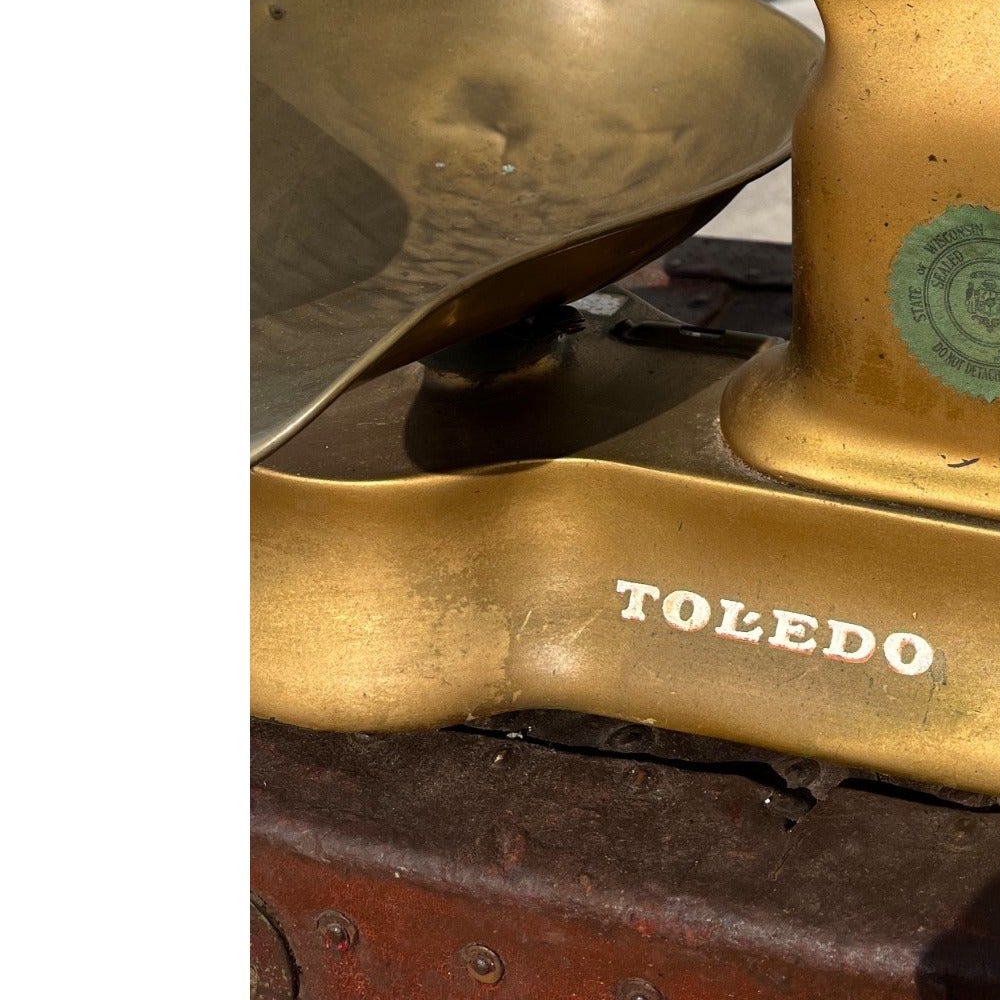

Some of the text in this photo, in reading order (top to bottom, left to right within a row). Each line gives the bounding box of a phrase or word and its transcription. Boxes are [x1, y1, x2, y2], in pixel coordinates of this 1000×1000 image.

[923, 223, 986, 255] WISCONSIN
[917, 263, 927, 276] OF
[931, 250, 965, 290] SEALED
[908, 286, 927, 323] STATE
[932, 342, 948, 359] DO
[945, 353, 964, 371] NOT
[964, 363, 1000, 383] DETACH
[615, 579, 935, 677] TOLEDO
